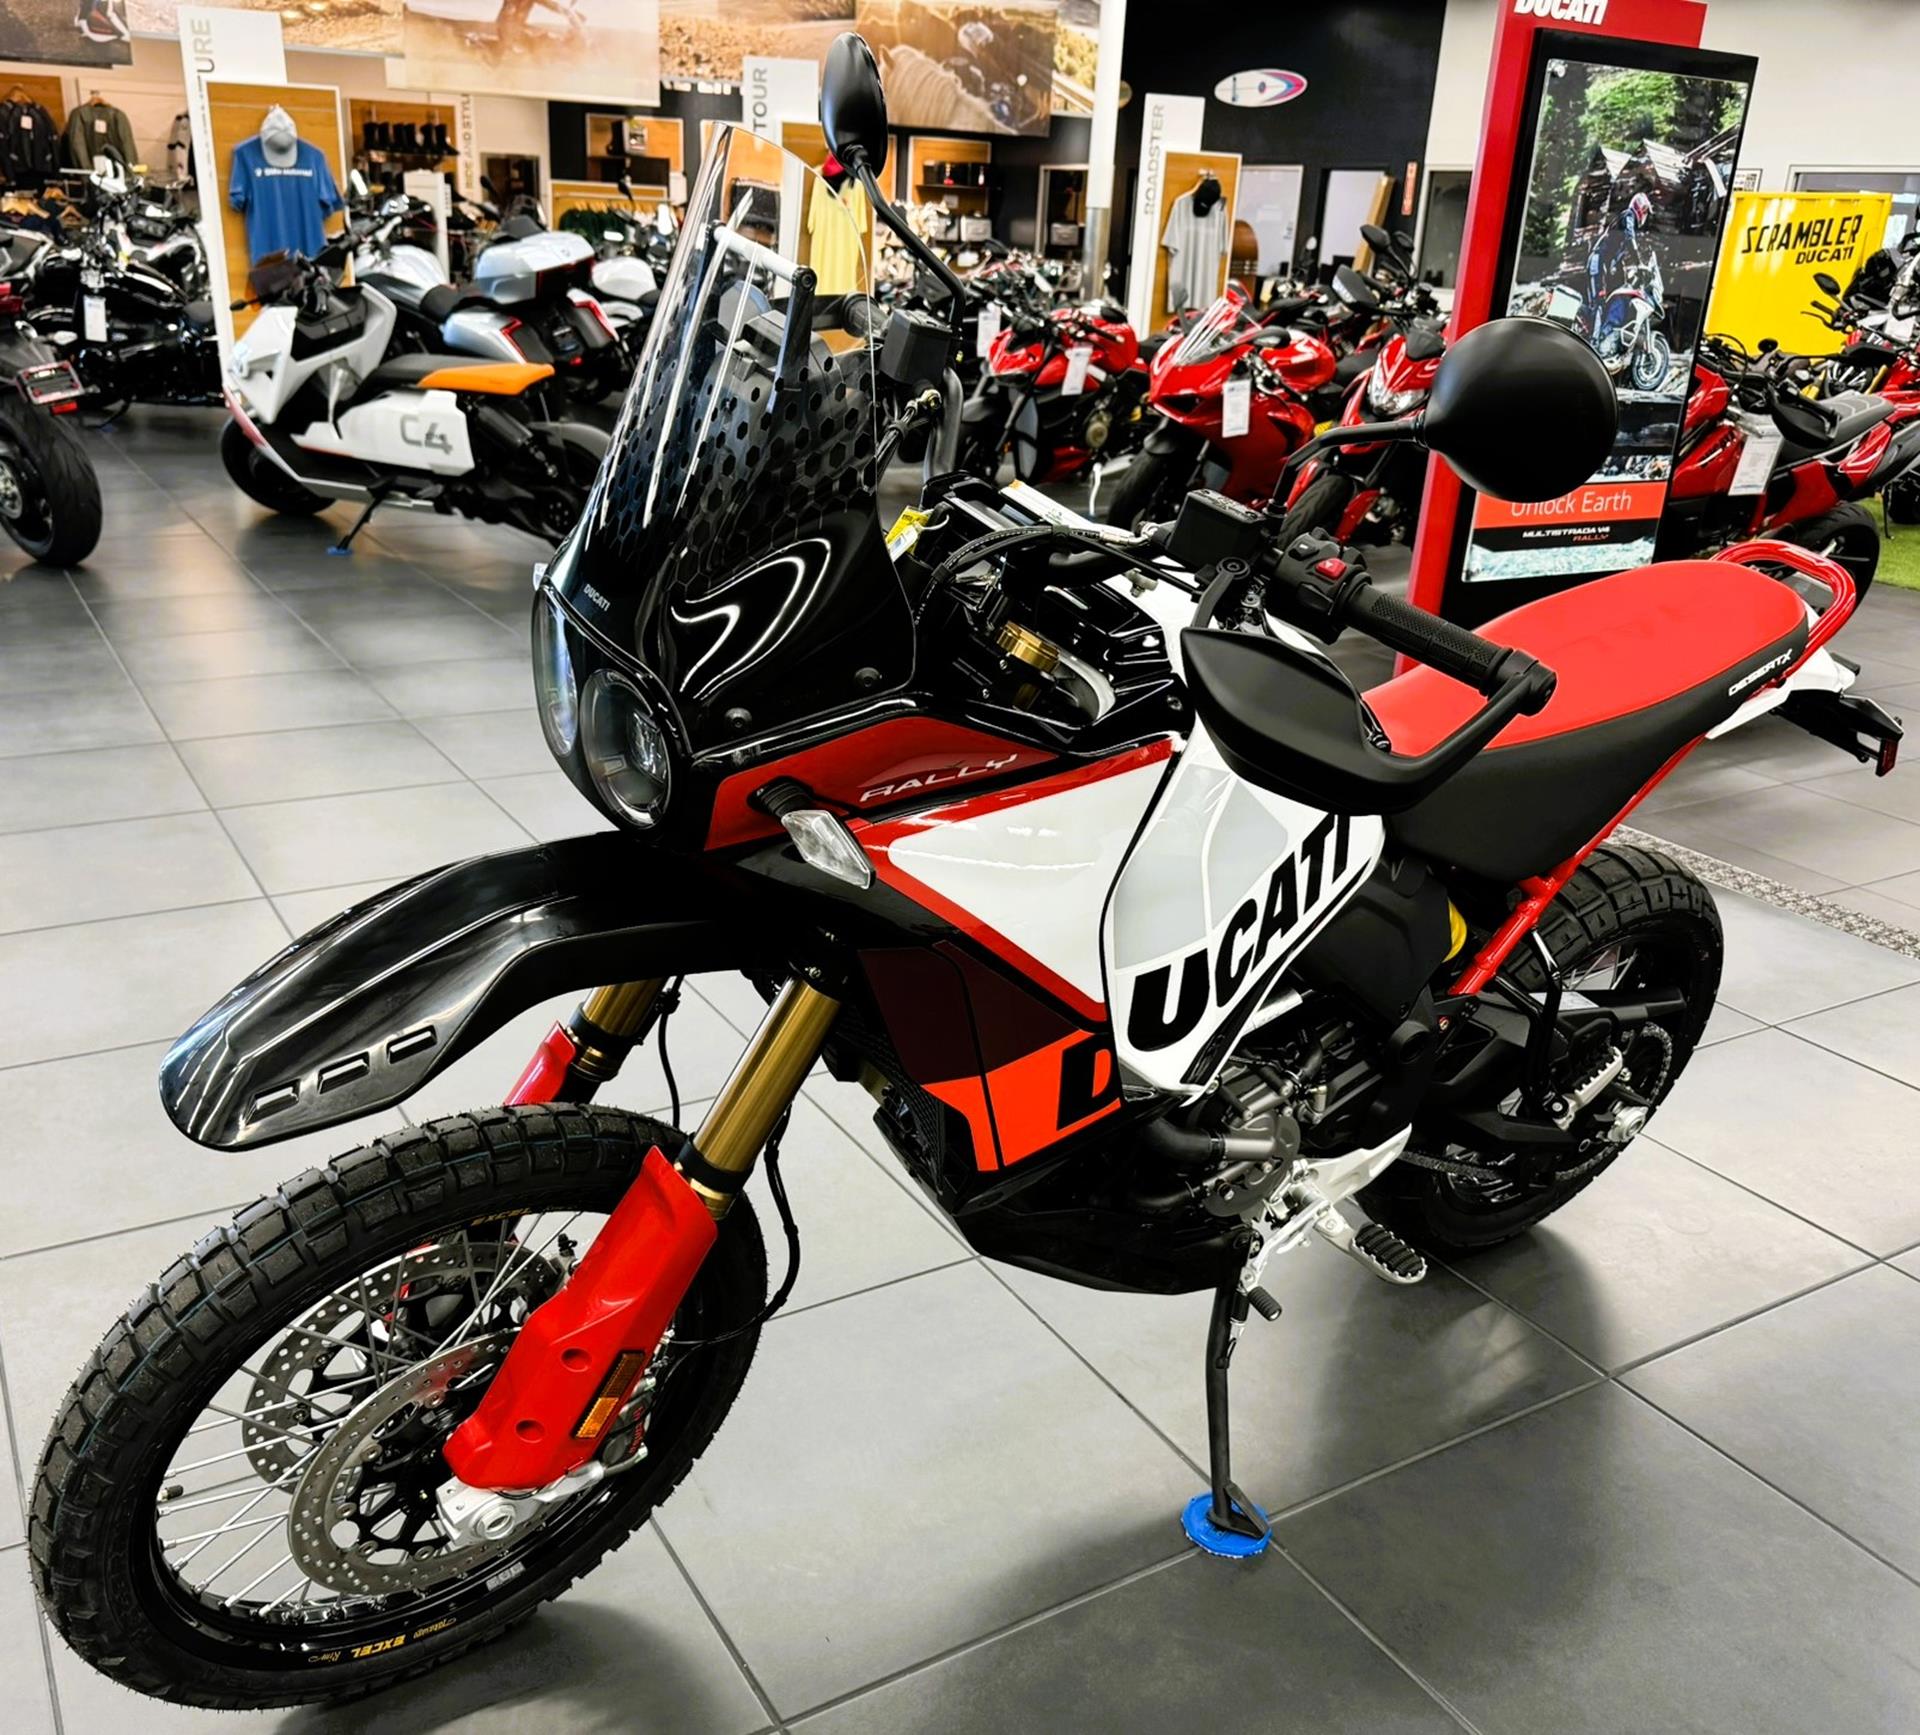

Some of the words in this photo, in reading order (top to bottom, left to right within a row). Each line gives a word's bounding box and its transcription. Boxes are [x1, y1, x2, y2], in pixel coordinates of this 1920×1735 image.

[1513, 0, 1608, 26] DUCATI
[752, 68, 767, 132] TOUR
[1143, 105, 1165, 215] ROADSTER
[1741, 215, 1863, 253] SCRAMBLER
[1795, 246, 1854, 265] DUCATI
[400, 414, 453, 455] C4
[1511, 492, 1575, 517] Unlock
[1581, 491, 1632, 513] Earth
[1522, 527, 1596, 538] MULTISTRADA
[1572, 533, 1609, 542] RALLY
[583, 583, 612, 612] DUCATI
[859, 753, 1018, 802] RALLY
[351, 1634, 406, 1658] EXCEL
